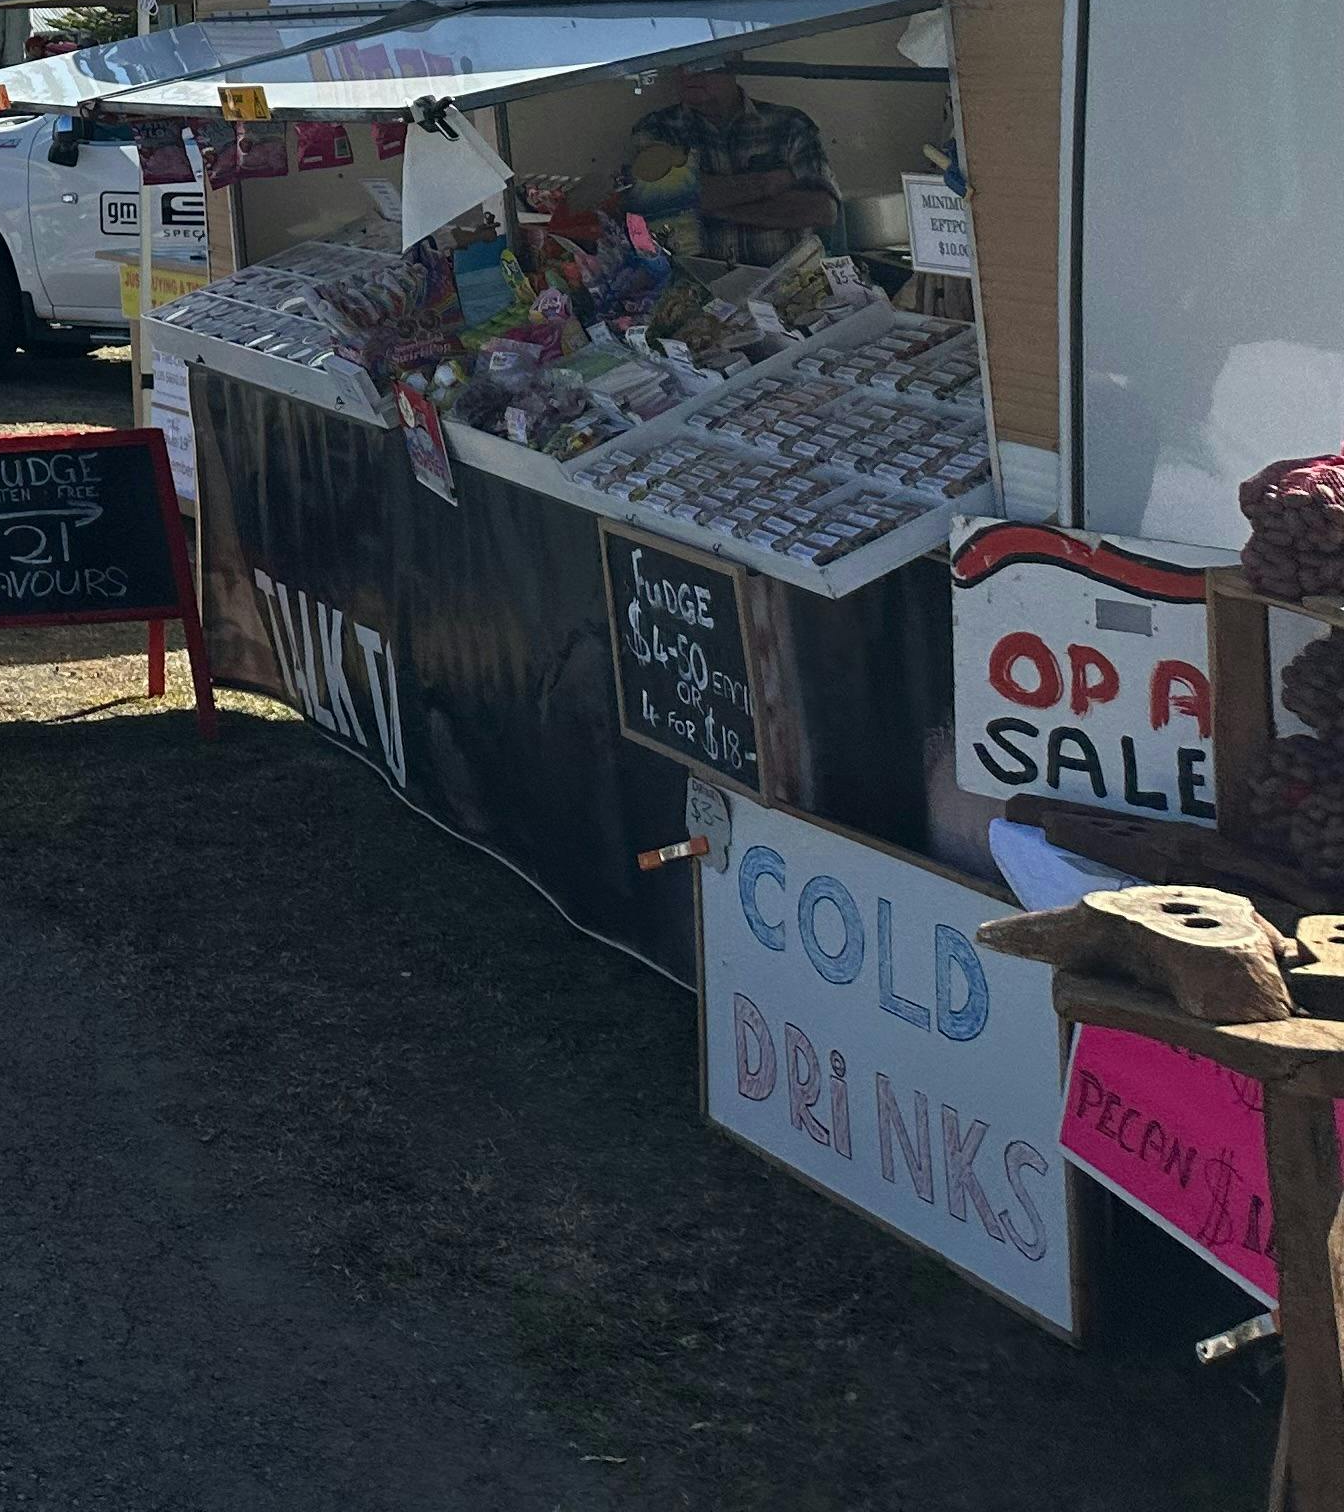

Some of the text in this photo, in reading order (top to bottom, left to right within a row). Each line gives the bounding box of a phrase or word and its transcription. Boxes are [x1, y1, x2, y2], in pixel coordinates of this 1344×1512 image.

[108, 202, 137, 224] gm
[56, 485, 100, 501] FREE
[4, 522, 72, 565] 21
[641, 689, 661, 728] 4
[667, 710, 697, 743] FOR
[676, 680, 705, 715] OR
[973, 717, 1216, 820] SALE
[738, 844, 990, 1044] COLD
[1076, 1068, 1198, 1189] PECAN
[1196, 1147, 1279, 1263] $1
